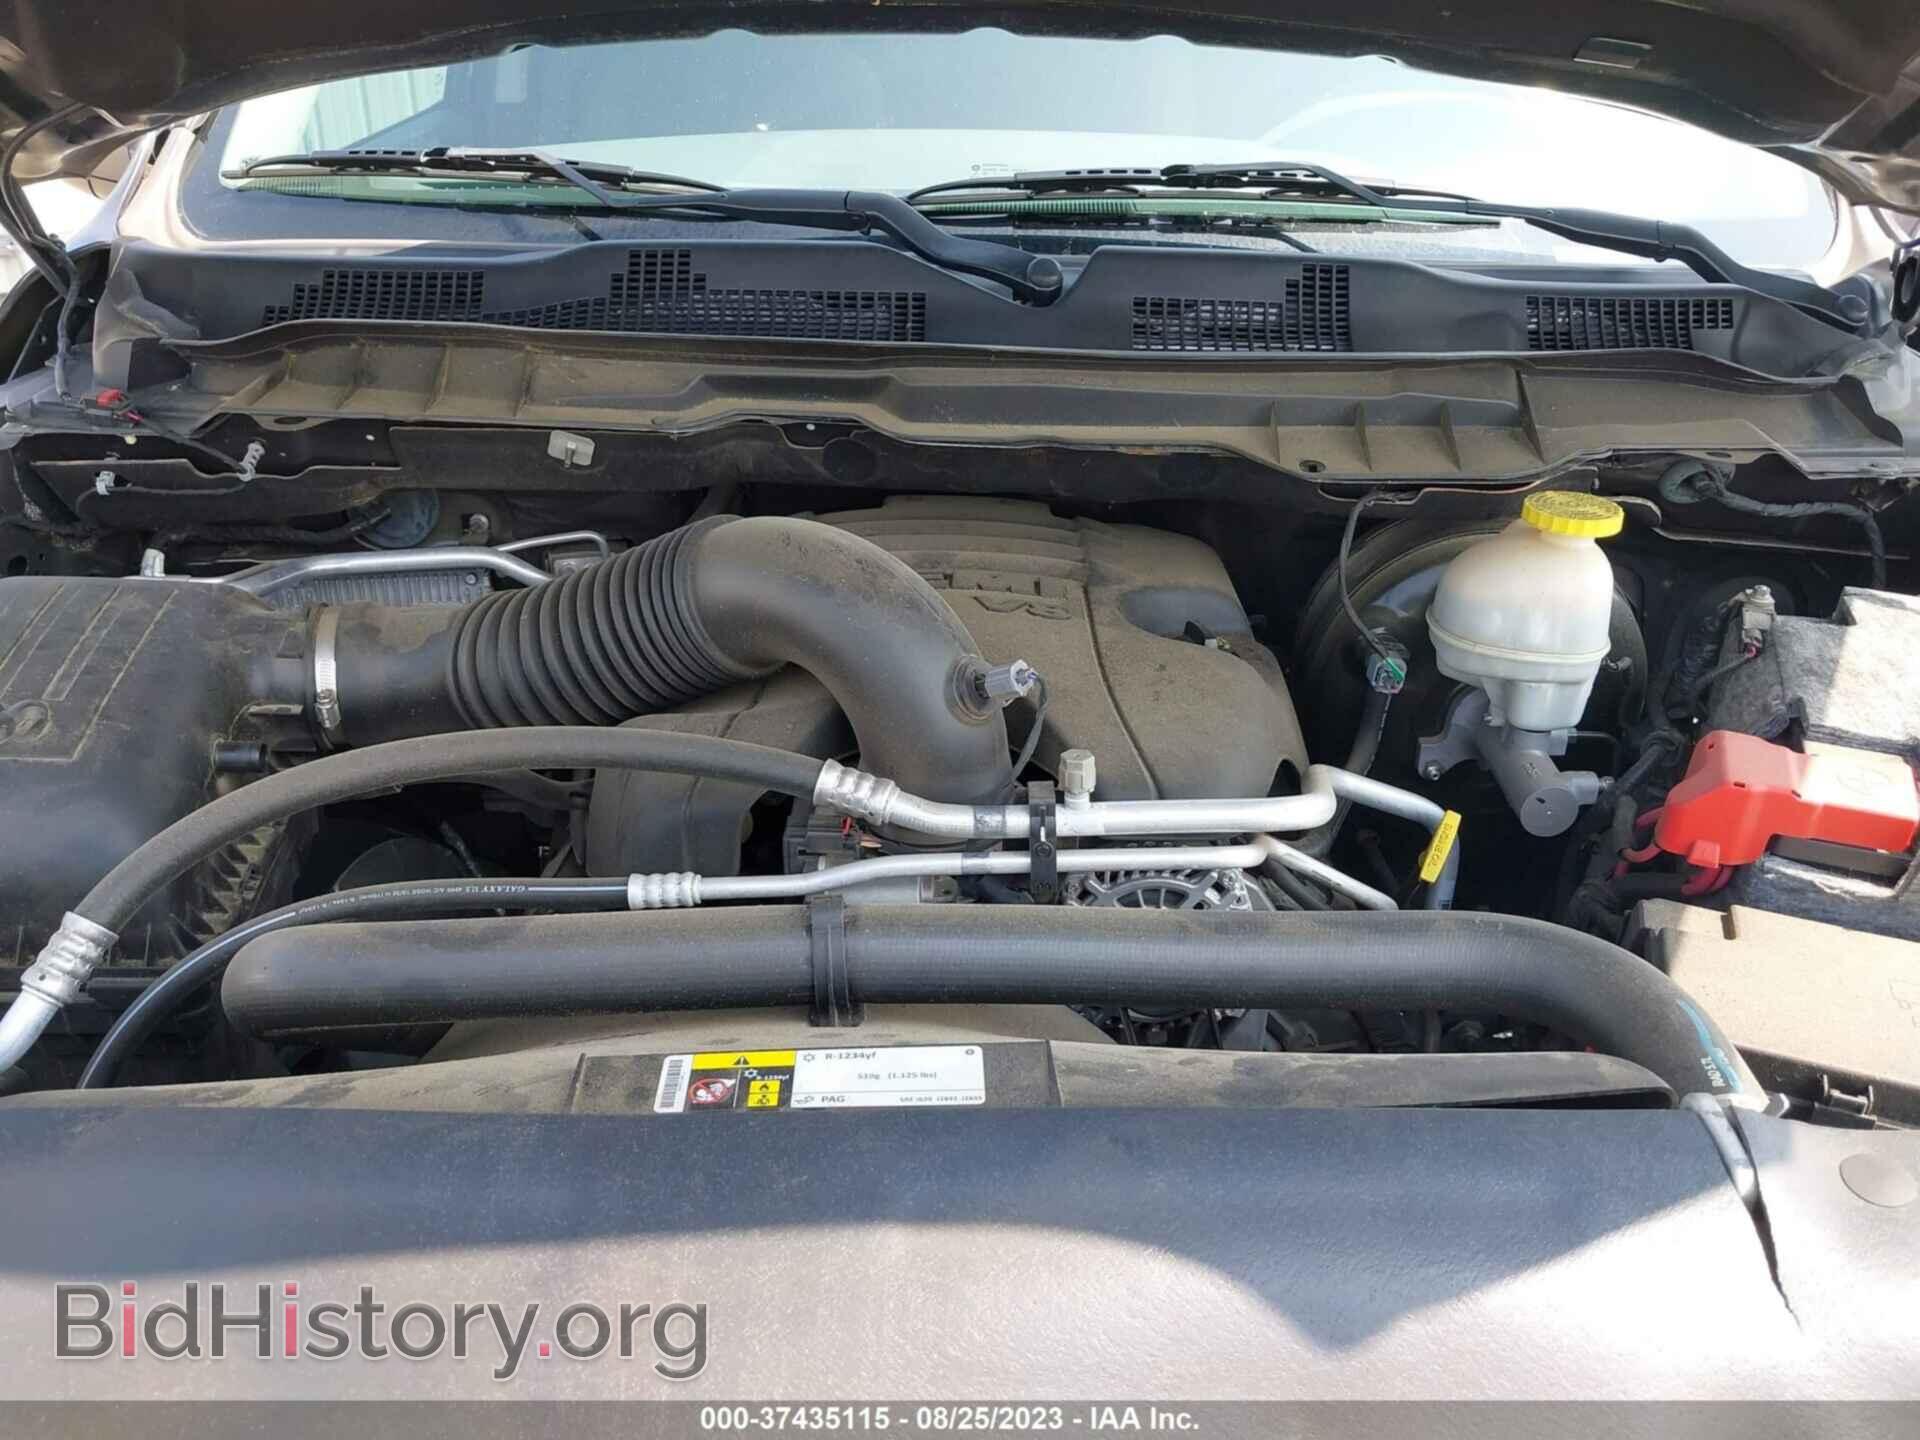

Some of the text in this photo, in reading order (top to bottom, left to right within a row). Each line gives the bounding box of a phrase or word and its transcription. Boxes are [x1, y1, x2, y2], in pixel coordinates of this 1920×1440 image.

[972, 596, 1072, 620] V8
[825, 1051, 877, 1061] R-1234yf
[821, 1095, 845, 1103] PAG
